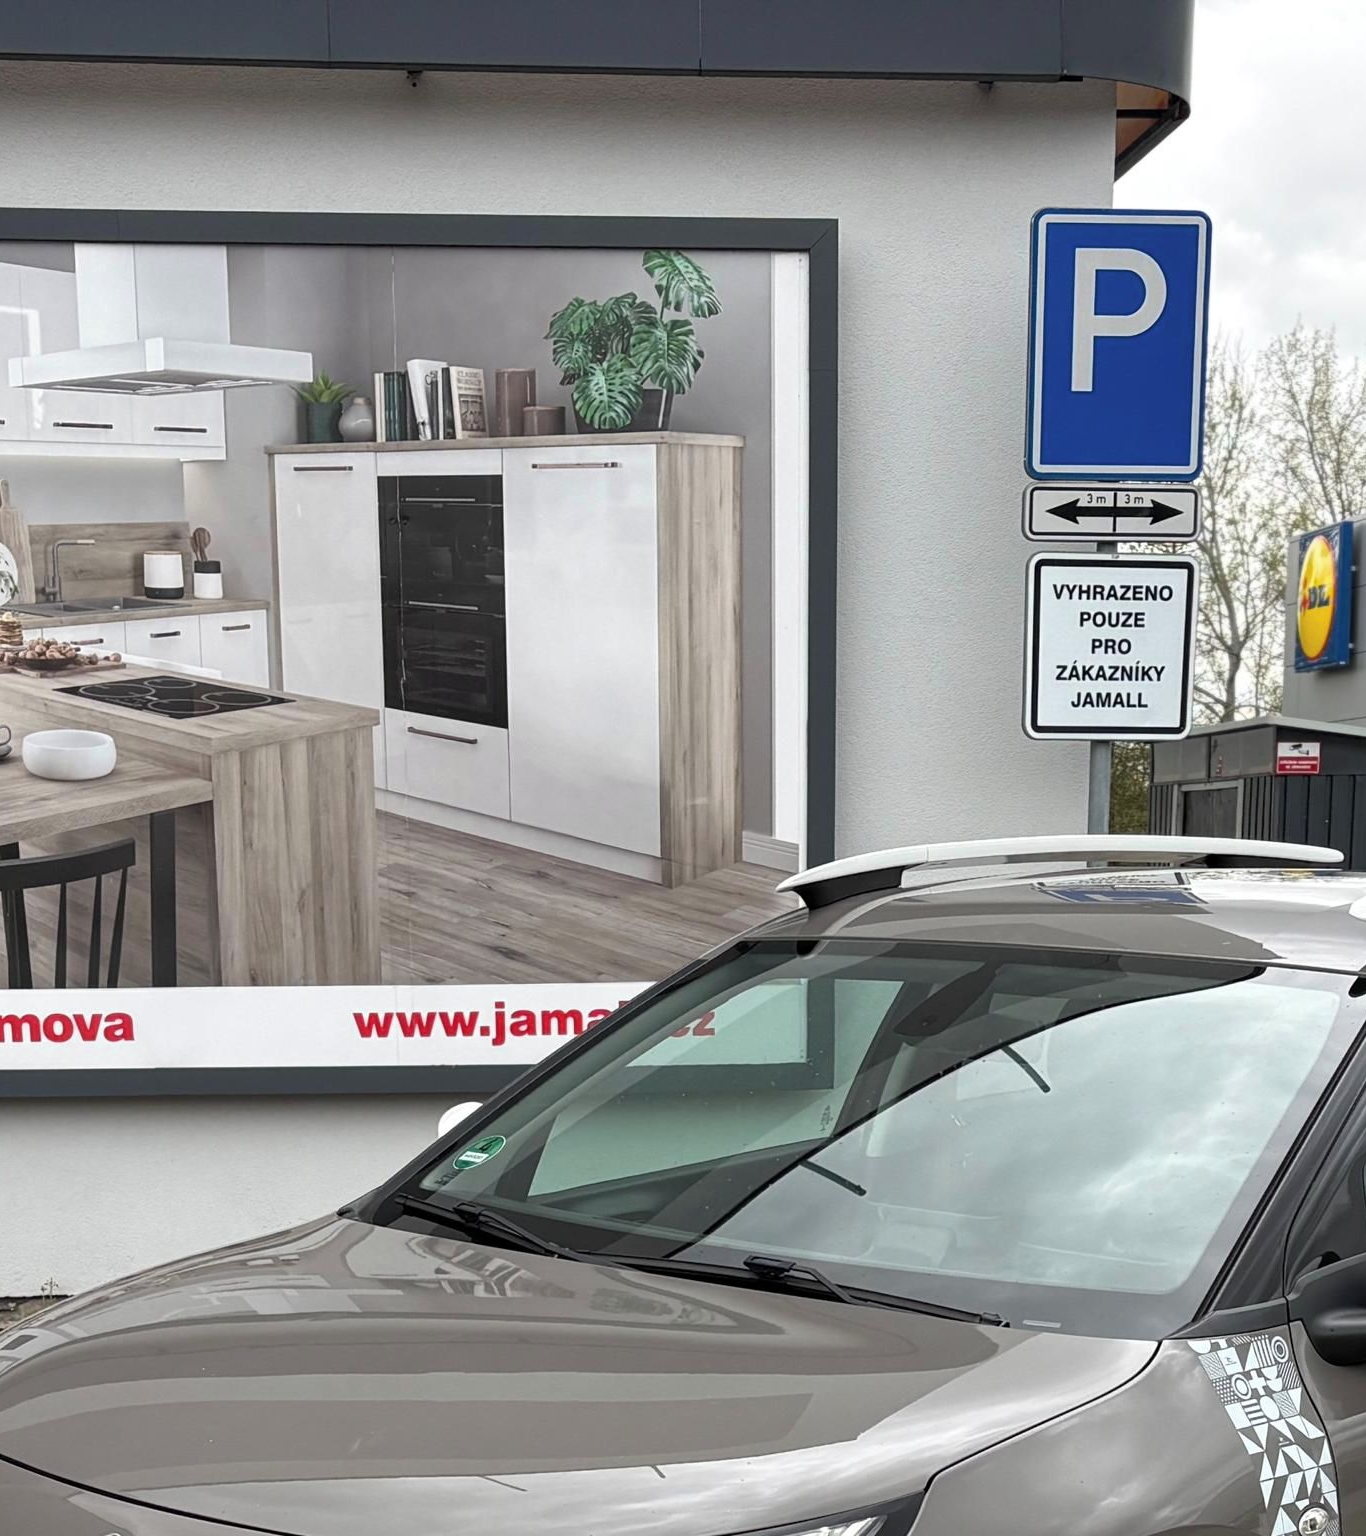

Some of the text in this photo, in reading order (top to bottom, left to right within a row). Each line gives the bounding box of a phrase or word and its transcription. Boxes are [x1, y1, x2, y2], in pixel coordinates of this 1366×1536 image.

[1070, 247, 1168, 393] P
[1086, 493, 1107, 504] 3 m
[1124, 494, 1145, 505] 3 m
[1052, 583, 1174, 602] VYHRAZENO
[1079, 611, 1146, 628] POUZE
[1091, 638, 1132, 655] PRO
[1055, 660, 1166, 682] ZÁKAZNÍKY
[1070, 692, 1149, 709] JAMALL
